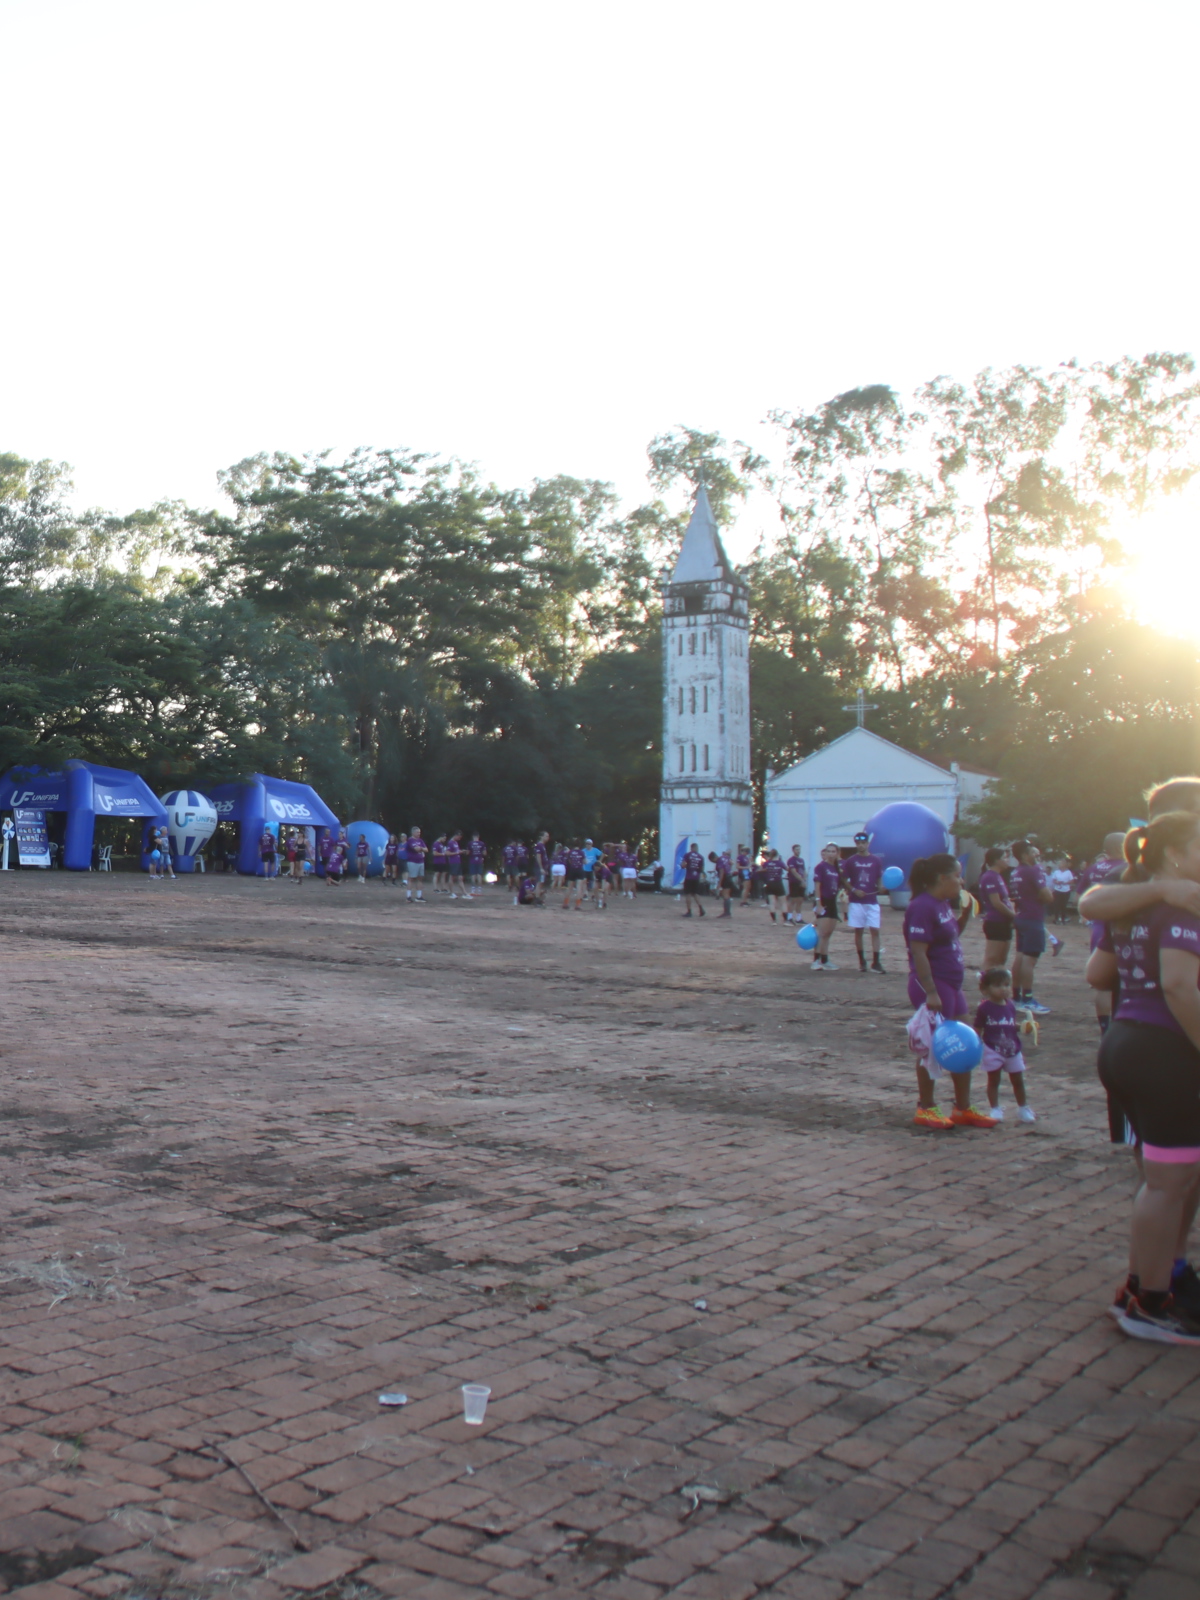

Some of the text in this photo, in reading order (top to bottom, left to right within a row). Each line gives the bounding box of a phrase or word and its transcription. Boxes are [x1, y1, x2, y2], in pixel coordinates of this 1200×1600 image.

[9, 790, 34, 807] UF
[97, 794, 115, 812] UF
[114, 798, 140, 806] UNIFIPA
[285, 803, 311, 819] pas
